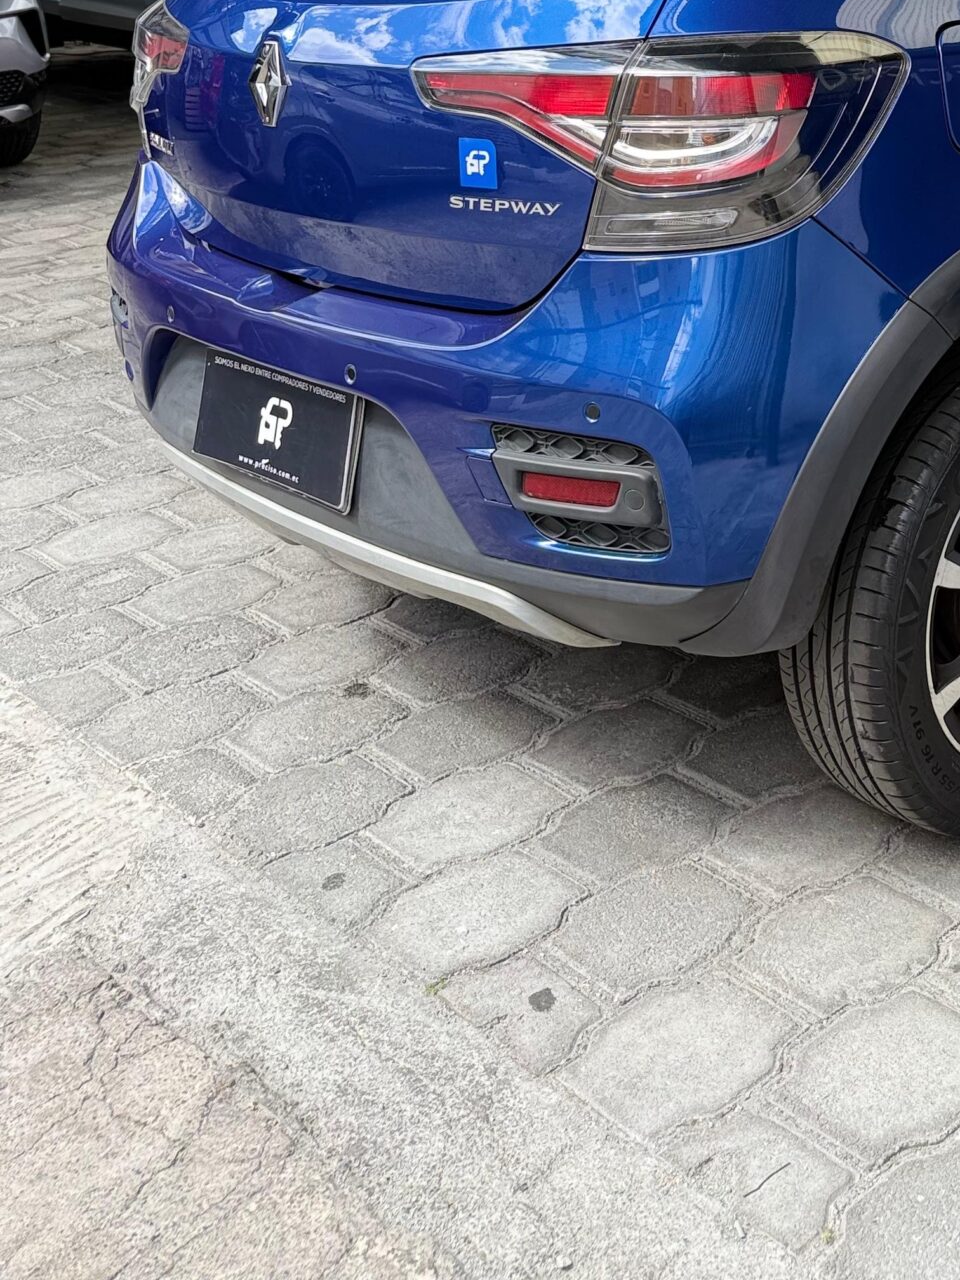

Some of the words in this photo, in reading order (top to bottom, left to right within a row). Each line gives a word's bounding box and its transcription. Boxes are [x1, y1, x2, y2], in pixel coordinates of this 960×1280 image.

[449, 195, 562, 217] STEPWAY
[214, 356, 234, 368] SOMOS
[234, 362, 241, 370] EL
[241, 363, 255, 374] NEXO
[255, 367, 272, 380] ENTRE
[272, 373, 309, 391] COMPRADORES
[313, 386, 347, 404] VENDEDORES
